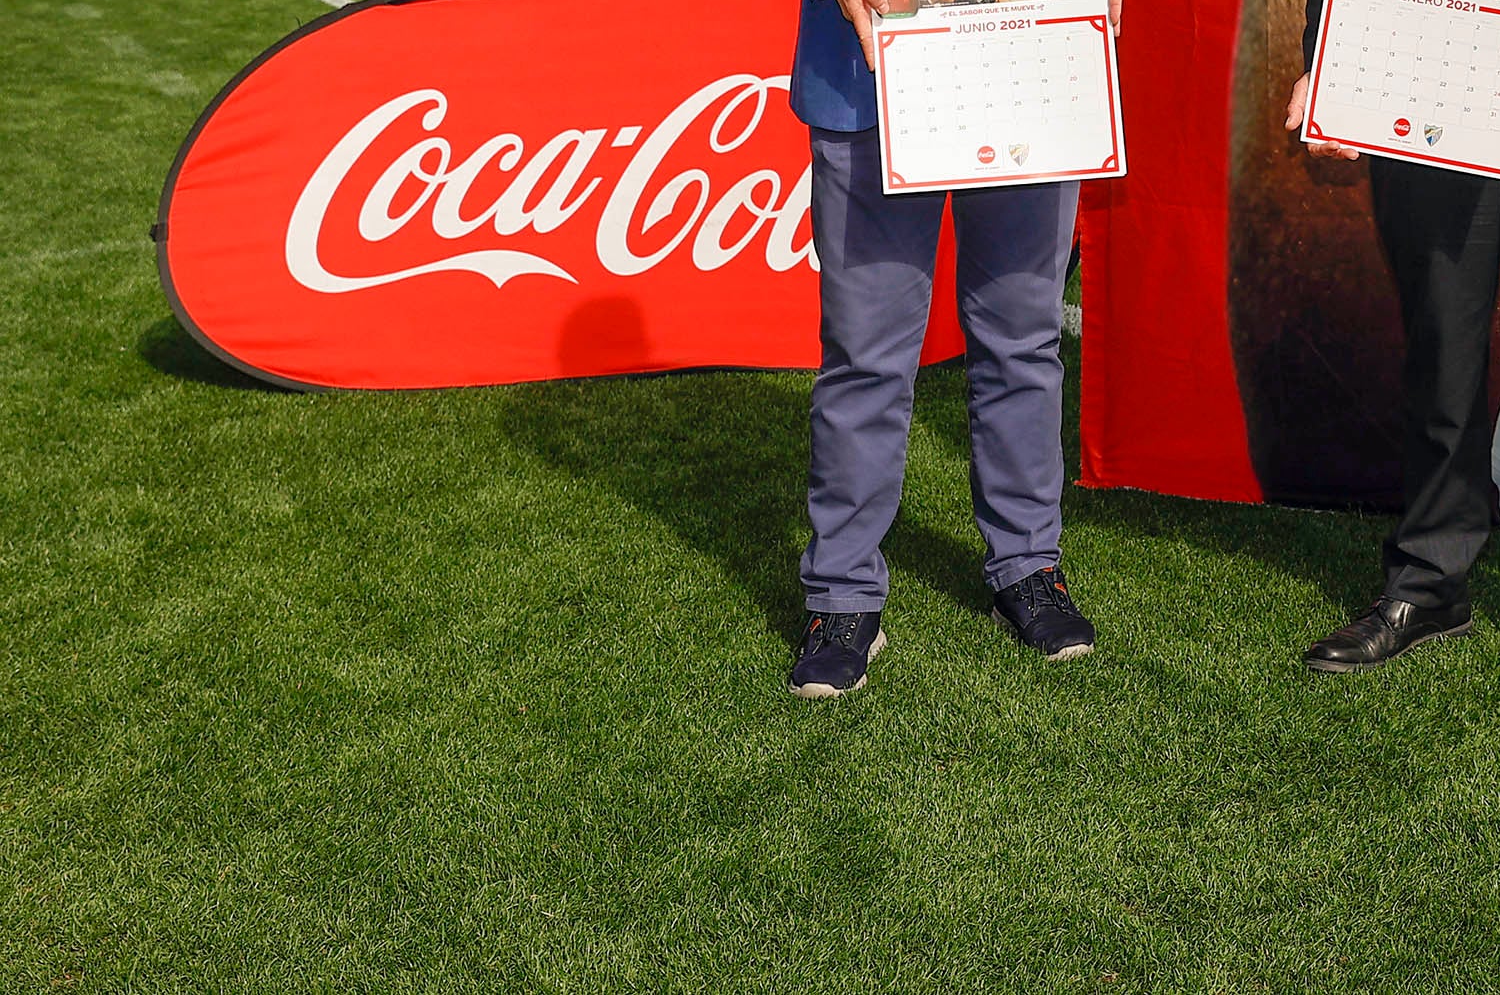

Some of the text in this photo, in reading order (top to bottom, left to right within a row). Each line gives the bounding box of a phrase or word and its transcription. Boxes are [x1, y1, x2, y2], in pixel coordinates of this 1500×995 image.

[1010, 4, 1035, 12] MUEVE
[955, 18, 1031, 34] JUNIO 2021
[285, 73, 821, 294] Coca-Col
